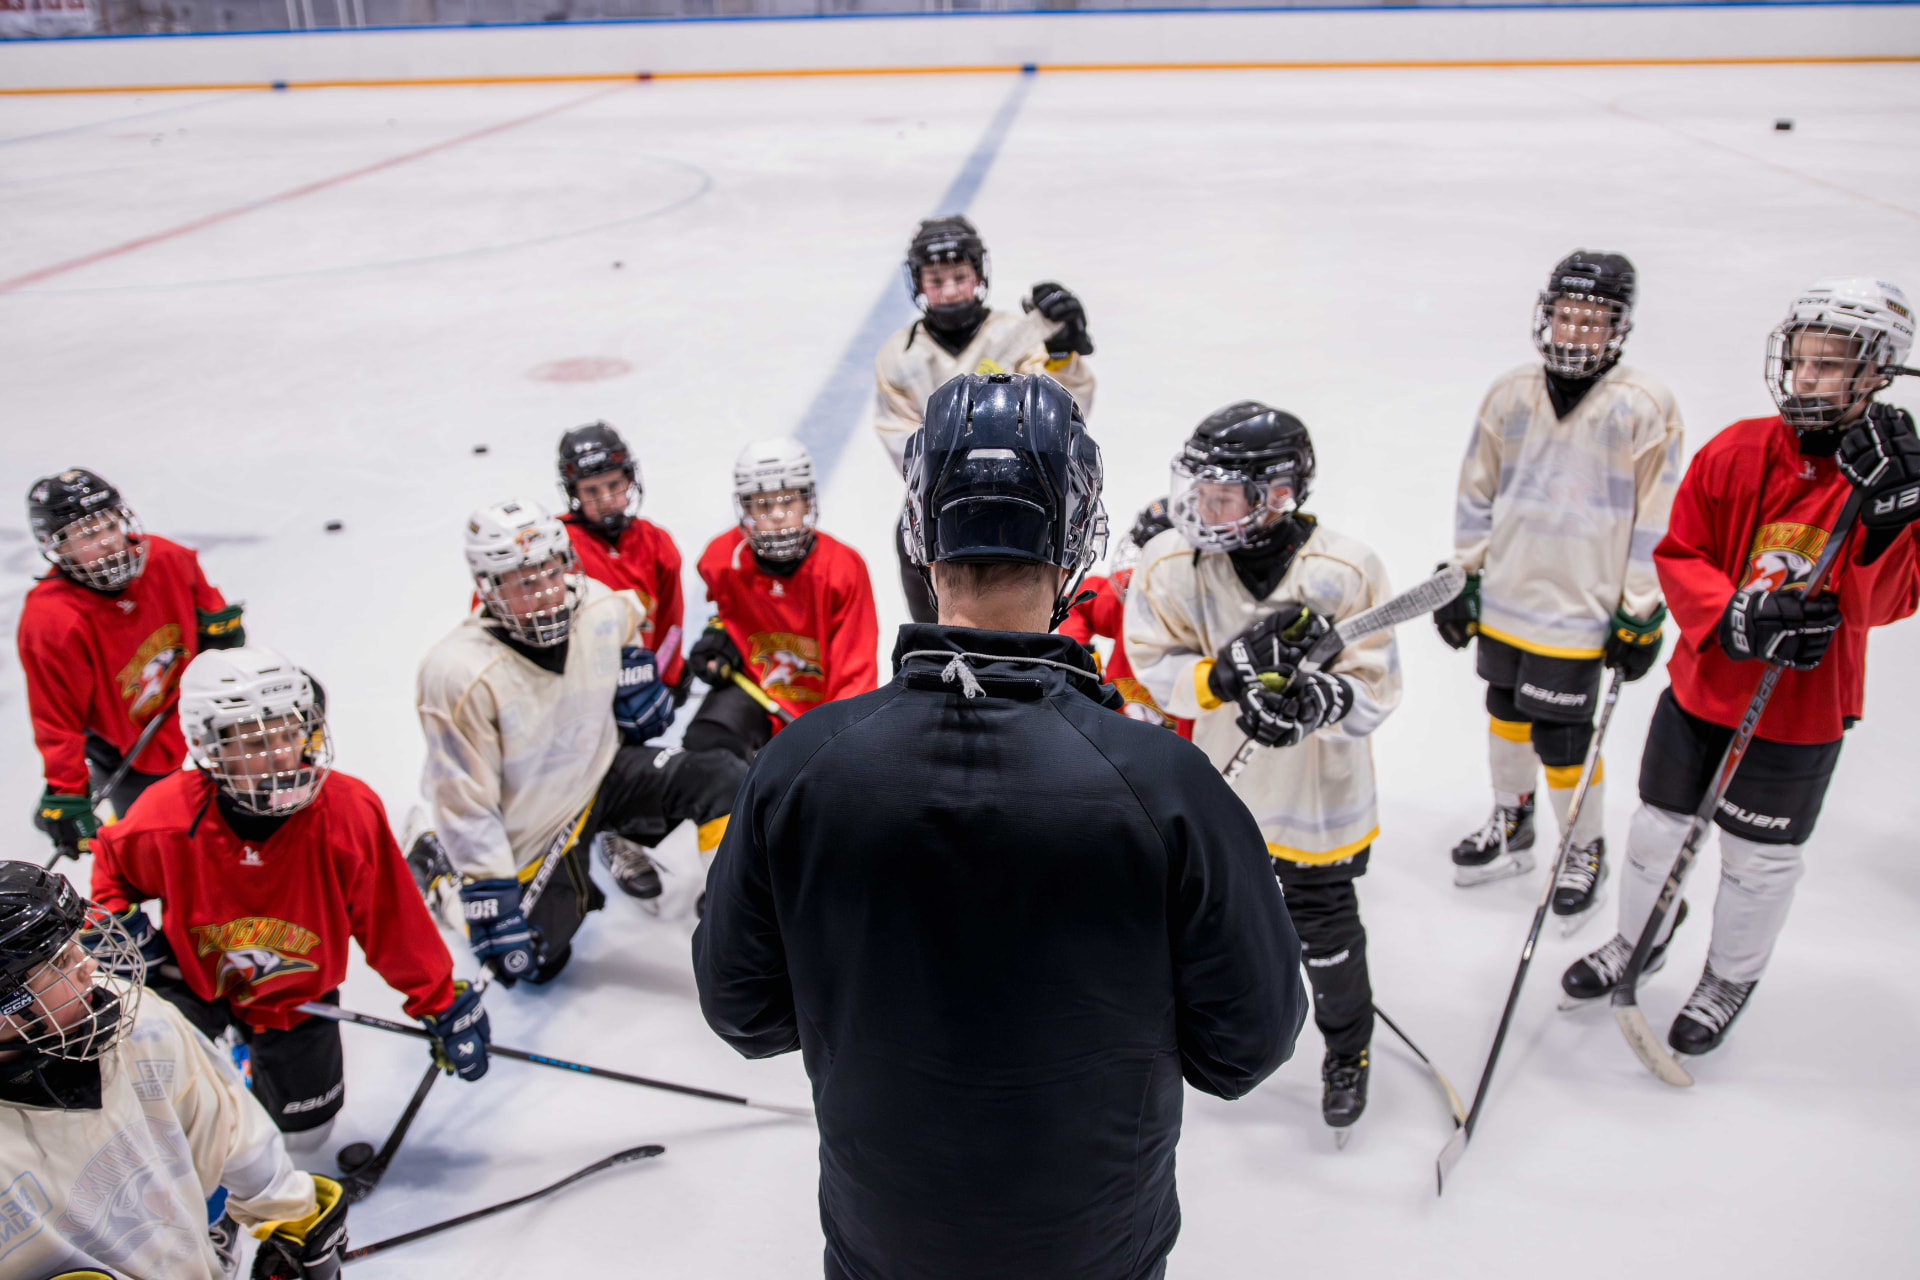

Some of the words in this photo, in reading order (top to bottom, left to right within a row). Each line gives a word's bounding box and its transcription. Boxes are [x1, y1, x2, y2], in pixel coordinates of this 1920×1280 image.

[1893, 321, 1913, 337] CCM
[261, 683, 293, 696] CCM
[1520, 682, 1588, 706] BAUER
[1738, 665, 1782, 738] SPEED
[3, 996, 32, 1016] CCM
[282, 1083, 344, 1115] BAUE
